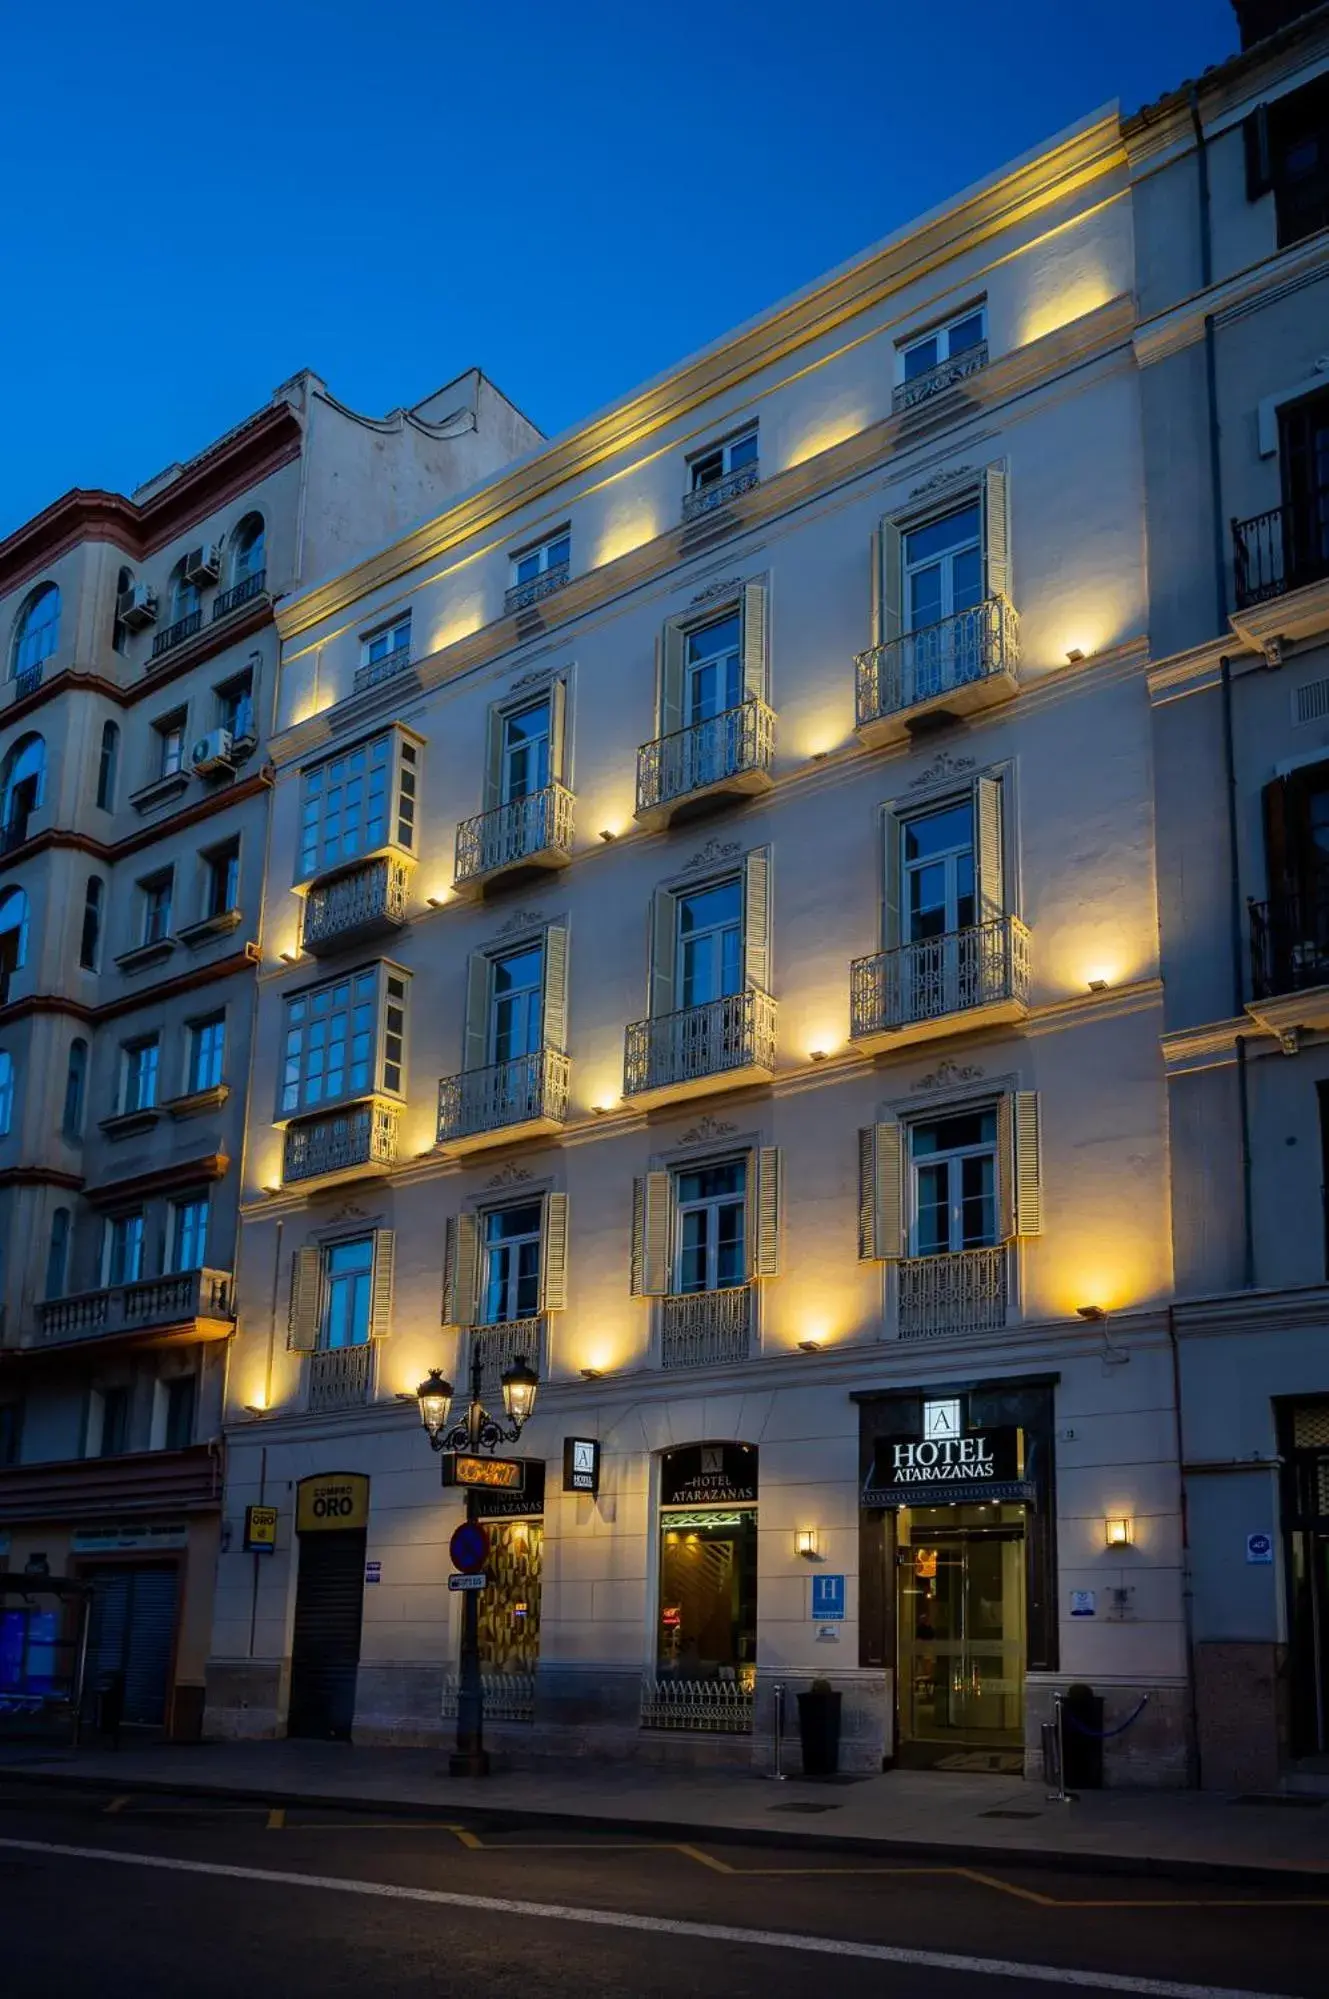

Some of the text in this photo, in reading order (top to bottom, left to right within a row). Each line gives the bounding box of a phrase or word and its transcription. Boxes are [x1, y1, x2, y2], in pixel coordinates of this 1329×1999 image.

[933, 1409, 950, 1431] A
[578, 1450, 588, 1466] A
[892, 1437, 994, 1468] HOTEL
[574, 1474, 592, 1484] HOTEL
[893, 1462, 994, 1483] ATARAZANAS
[692, 1475, 732, 1487] HOTEL
[314, 1486, 353, 1497] COMPRO
[672, 1486, 754, 1502] ATARAZANAS
[313, 1497, 353, 1517] ORO
[253, 1515, 274, 1525] ORO
[820, 1579, 837, 1600] H
